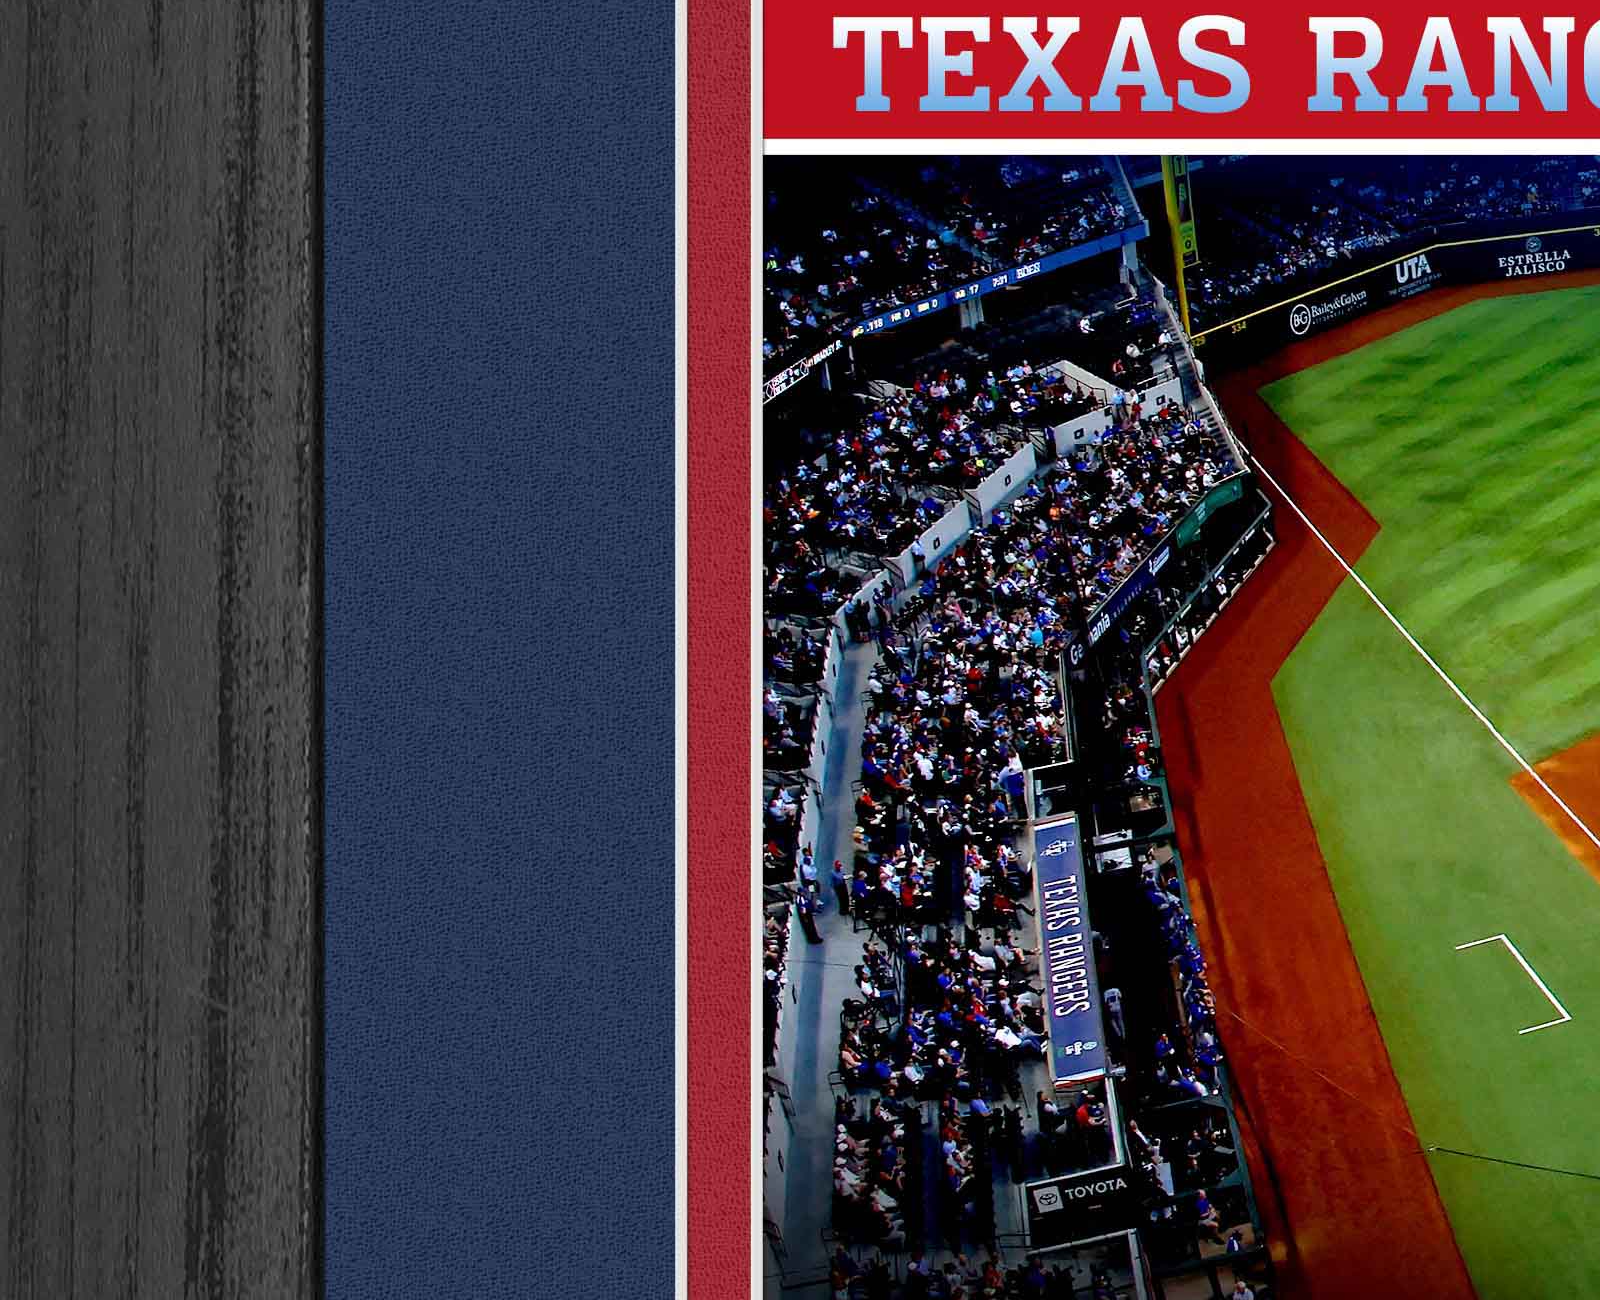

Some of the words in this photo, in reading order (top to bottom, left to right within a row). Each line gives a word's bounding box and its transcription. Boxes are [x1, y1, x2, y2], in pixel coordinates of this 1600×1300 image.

[833, 14, 1251, 114] TEXAS
[1395, 253, 1432, 284] UTA
[1498, 249, 1571, 268] ESTRELLA
[1505, 260, 1565, 277] JALISCO
[1043, 874, 1081, 932] TEXAS
[1048, 932, 1092, 1018] RANGERS
[1065, 1178, 1128, 1201] TOYOTA
